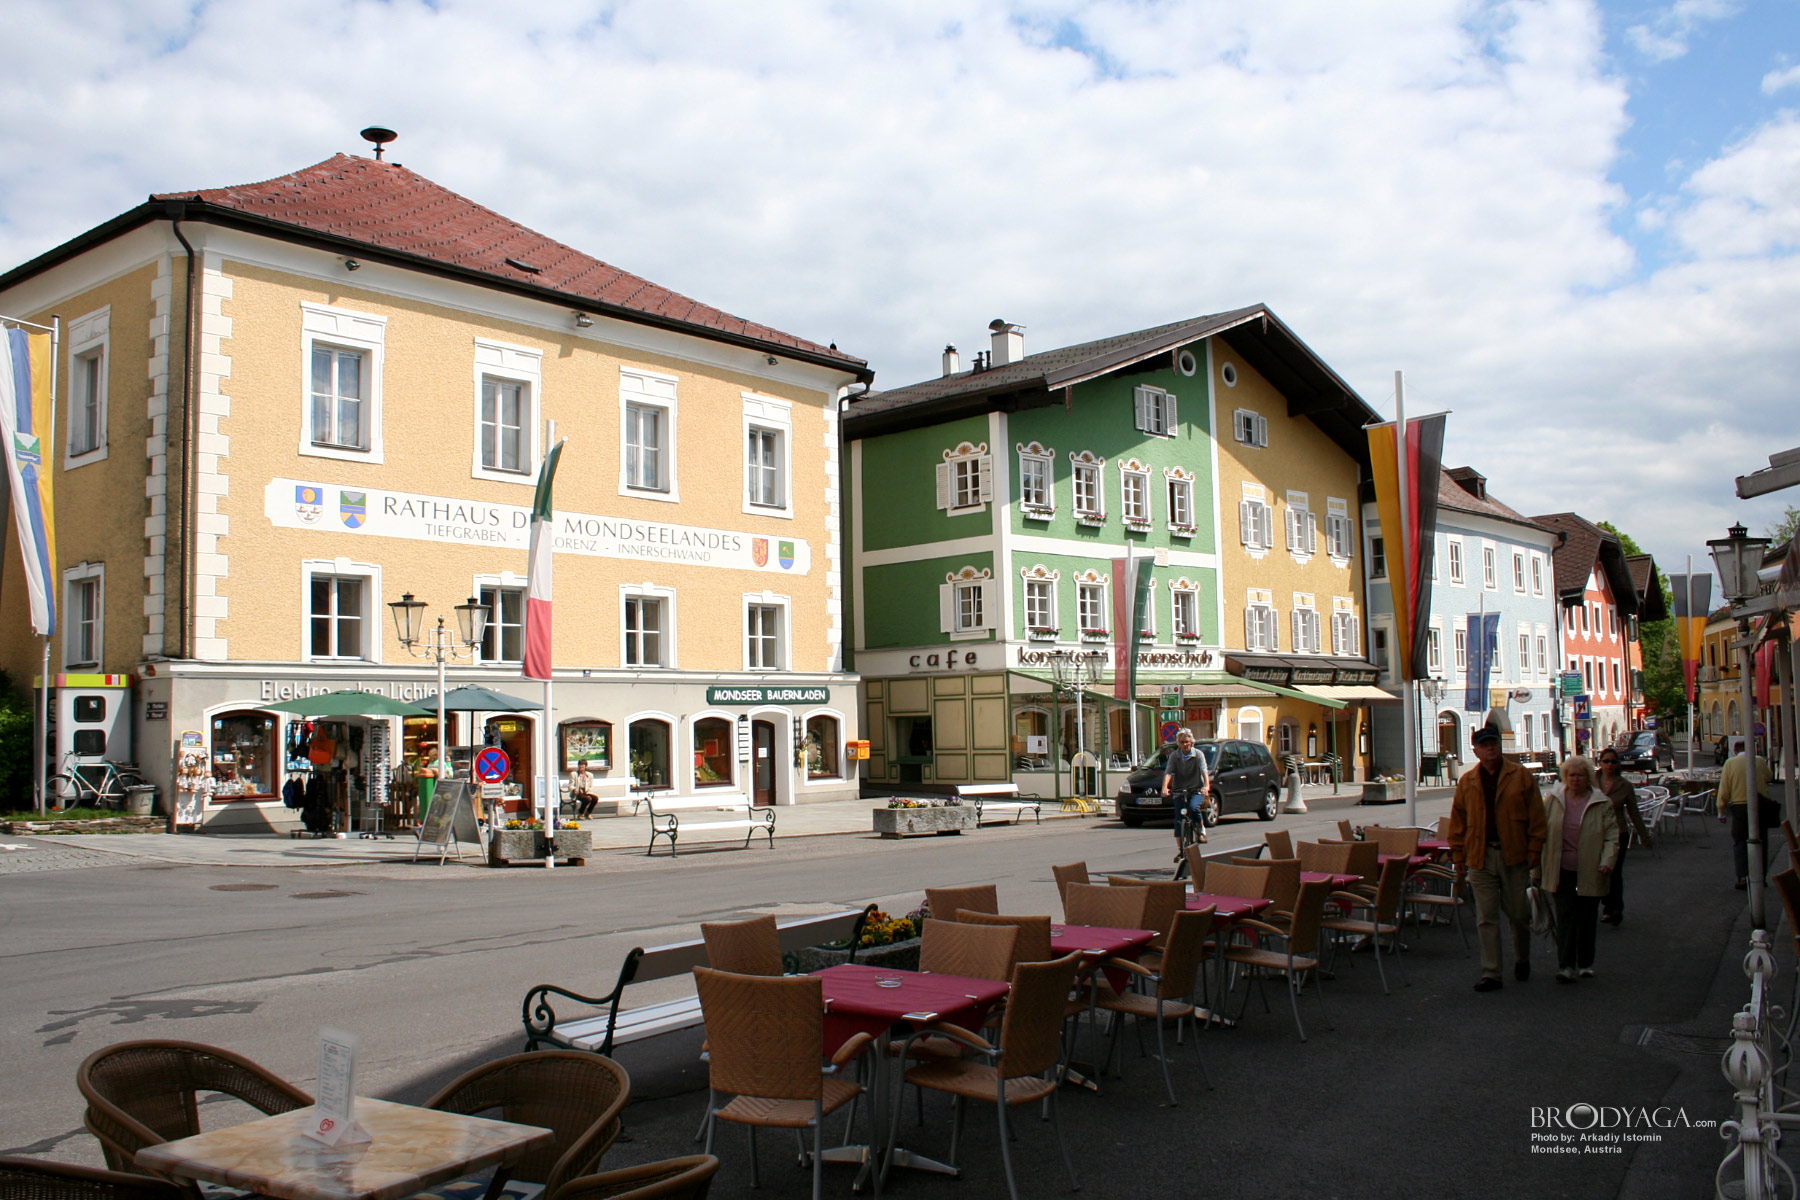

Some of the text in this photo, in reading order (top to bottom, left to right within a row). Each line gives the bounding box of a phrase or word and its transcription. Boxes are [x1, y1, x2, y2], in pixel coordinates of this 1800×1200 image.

[384, 496, 500, 527] RATHAUS
[564, 517, 741, 552] MONDSEELANDES
[425, 523, 711, 562] TIEFGRABEN ORENZ INNERSCHWAND
[909, 649, 977, 669] cafe
[260, 680, 332, 701] Elektro
[713, 689, 826, 701] MONDSEER BAUERNLADEN
